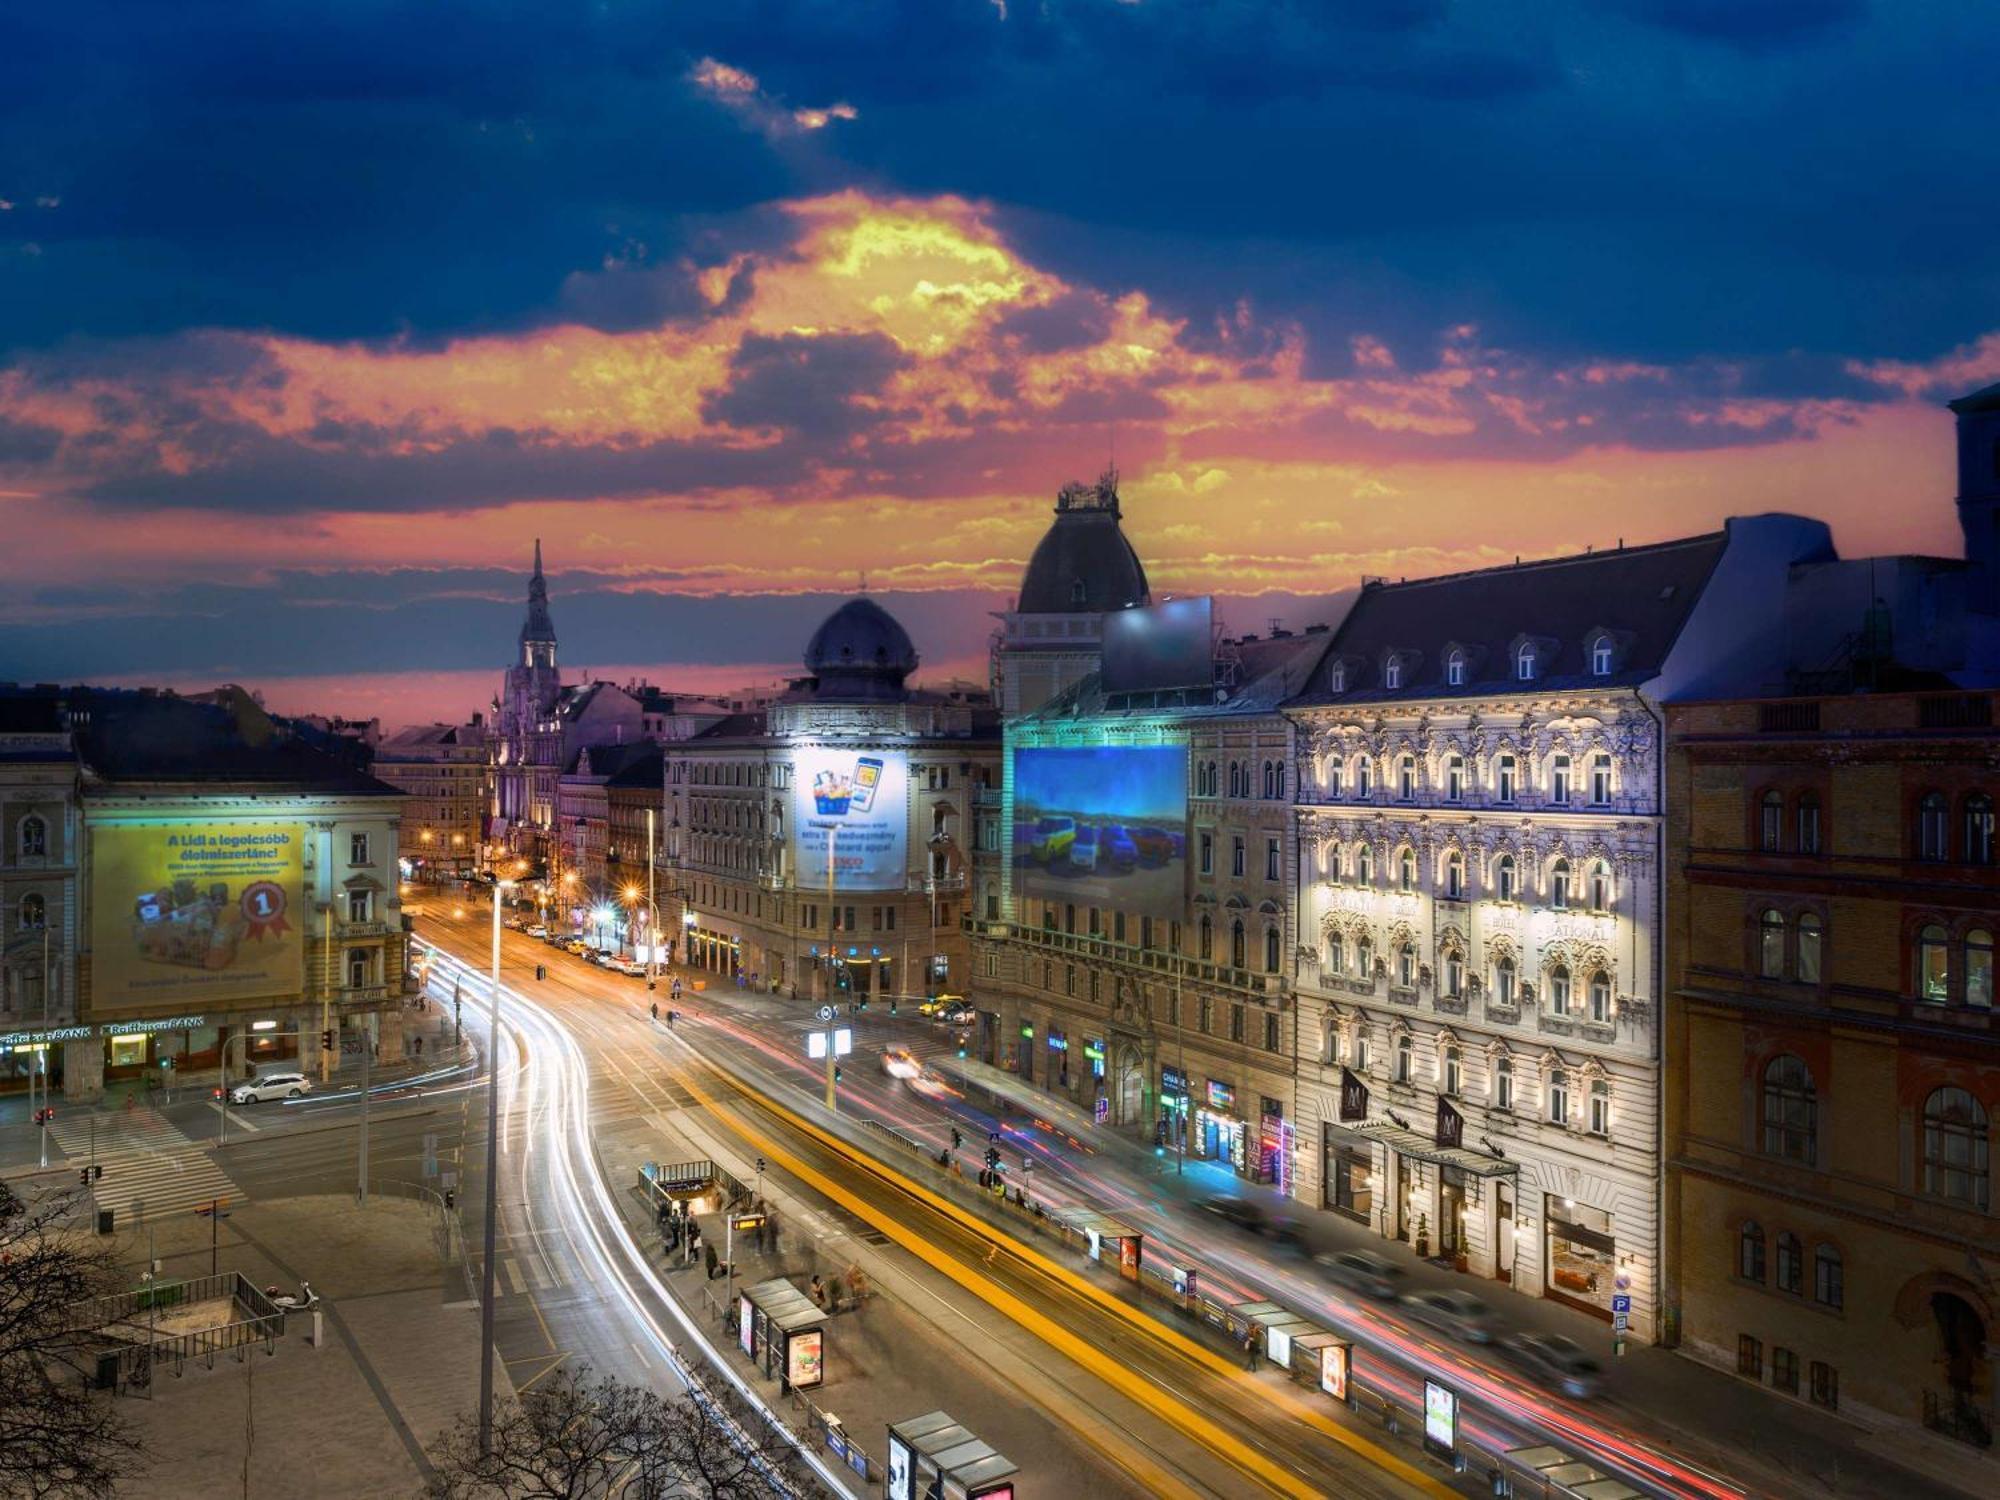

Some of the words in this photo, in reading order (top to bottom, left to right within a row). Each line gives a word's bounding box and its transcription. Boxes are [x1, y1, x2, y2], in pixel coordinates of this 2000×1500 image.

[168, 835, 178, 846] A
[181, 834, 206, 846] Lidl
[255, 891, 272, 915] 1
[1616, 1300, 1626, 1310] P
